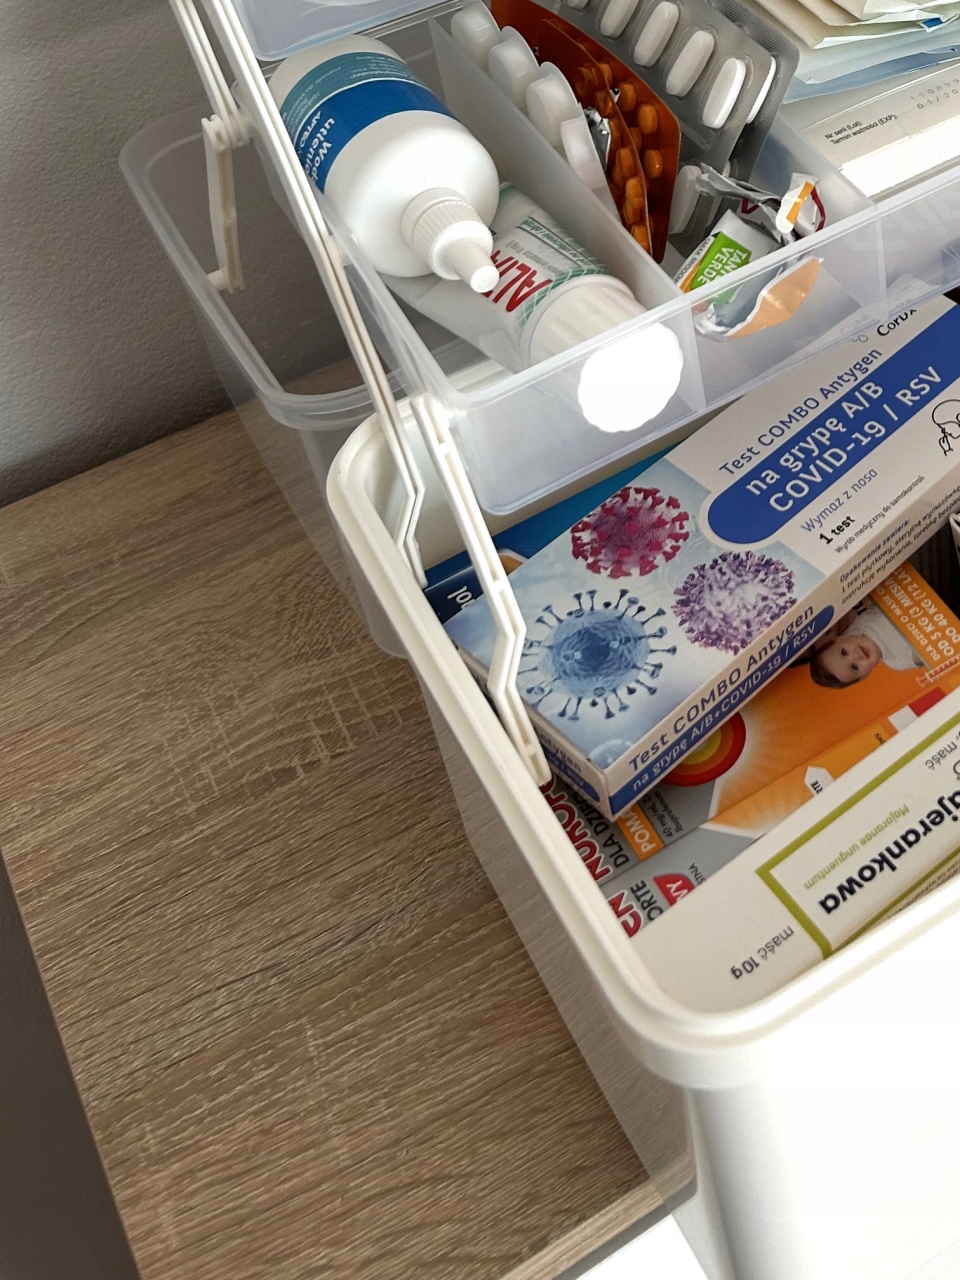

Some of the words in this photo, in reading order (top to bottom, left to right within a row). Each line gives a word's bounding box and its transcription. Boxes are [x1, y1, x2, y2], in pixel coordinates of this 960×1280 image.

[719, 446, 761, 477] Test
[757, 397, 820, 447] COMBO
[819, 348, 883, 400] Antygen
[746, 469, 781, 496] na
[779, 417, 847, 472] grypę
[841, 381, 883, 419] A/B
[769, 420, 886, 512] COVID-19
[895, 366, 942, 406] RSV
[801, 497, 845, 534] Wymaz
[843, 490, 852, 500] z
[850, 468, 878, 493] nosa
[819, 532, 834, 545] 1
[831, 516, 855, 538] test
[855, 511, 886, 537] medyczny
[882, 505, 892, 514] do
[839, 541, 882, 583] Opakowanie
[883, 593, 904, 616] MASIE
[907, 582, 925, 599] (12
[901, 615, 908, 623] O
[909, 606, 924, 617] (3
[921, 598, 938, 614] KG
[934, 613, 948, 627] 40
[906, 622, 929, 646] DZIECI
[918, 617, 935, 633] KG
[930, 631, 941, 640] 5
[926, 644, 941, 661] DLA
[938, 639, 954, 656] OD
[628, 732, 669, 771] Test
[672, 667, 742, 734] COMBO
[746, 605, 814, 672] Antygen
[632, 772, 650, 791] na
[652, 738, 688, 775] grypę
[691, 652, 781, 740] A/B+COVID-19
[792, 621, 816, 649] RSV
[924, 741, 957, 771] maść
[662, 827, 674, 838] 40
[859, 803, 910, 849] Majoranae
[602, 834, 629, 869] DLA
[803, 842, 860, 890] unguentum
[757, 925, 795, 960] maść
